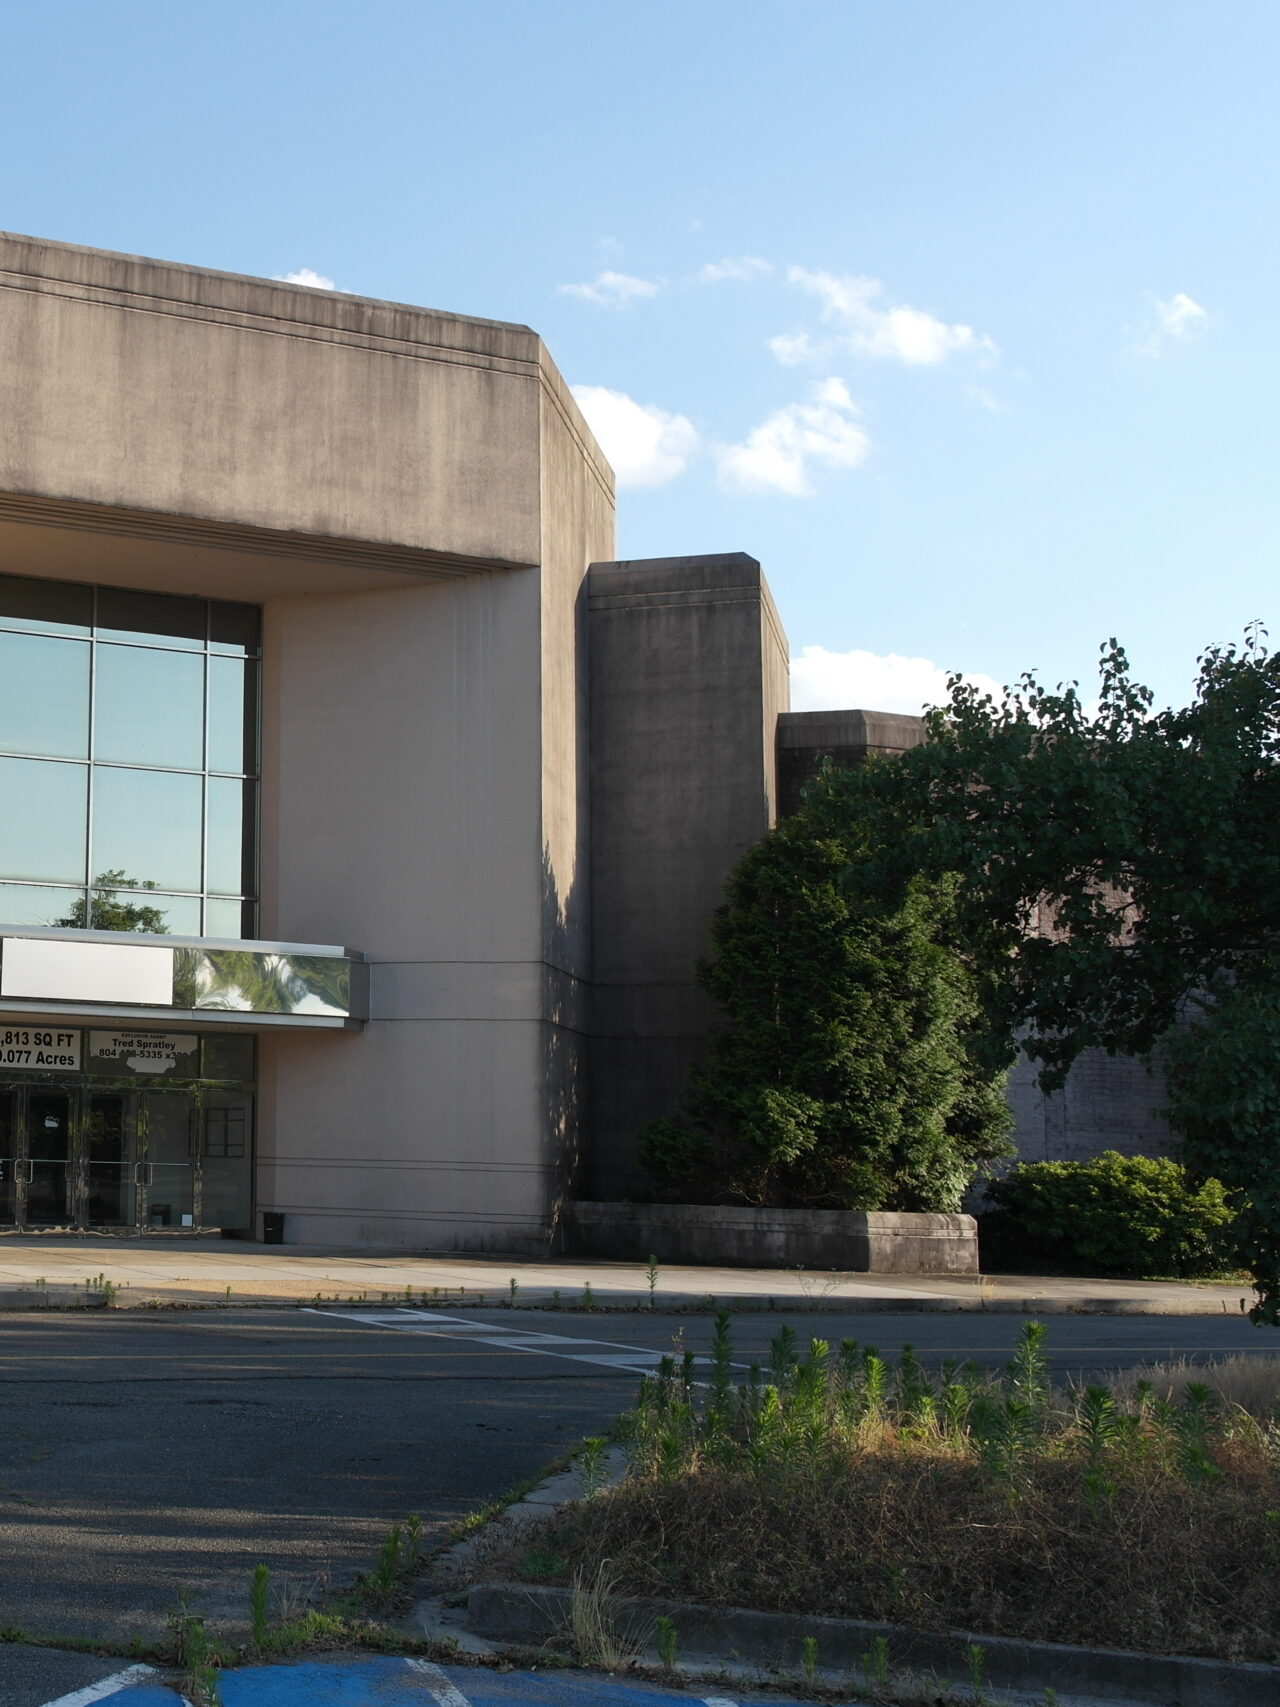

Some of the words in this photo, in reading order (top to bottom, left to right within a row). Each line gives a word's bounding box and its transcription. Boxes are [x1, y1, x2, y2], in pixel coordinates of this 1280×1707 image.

[33, 1032, 53, 1047] SQ
[57, 1033, 74, 1047] FT
[112, 1038, 134, 1048] Tred
[136, 1039, 176, 1051] Spratley
[35, 1050, 75, 1066] Acres
[99, 1048, 117, 1057] 804
[120, 1049, 163, 1060] -5335
